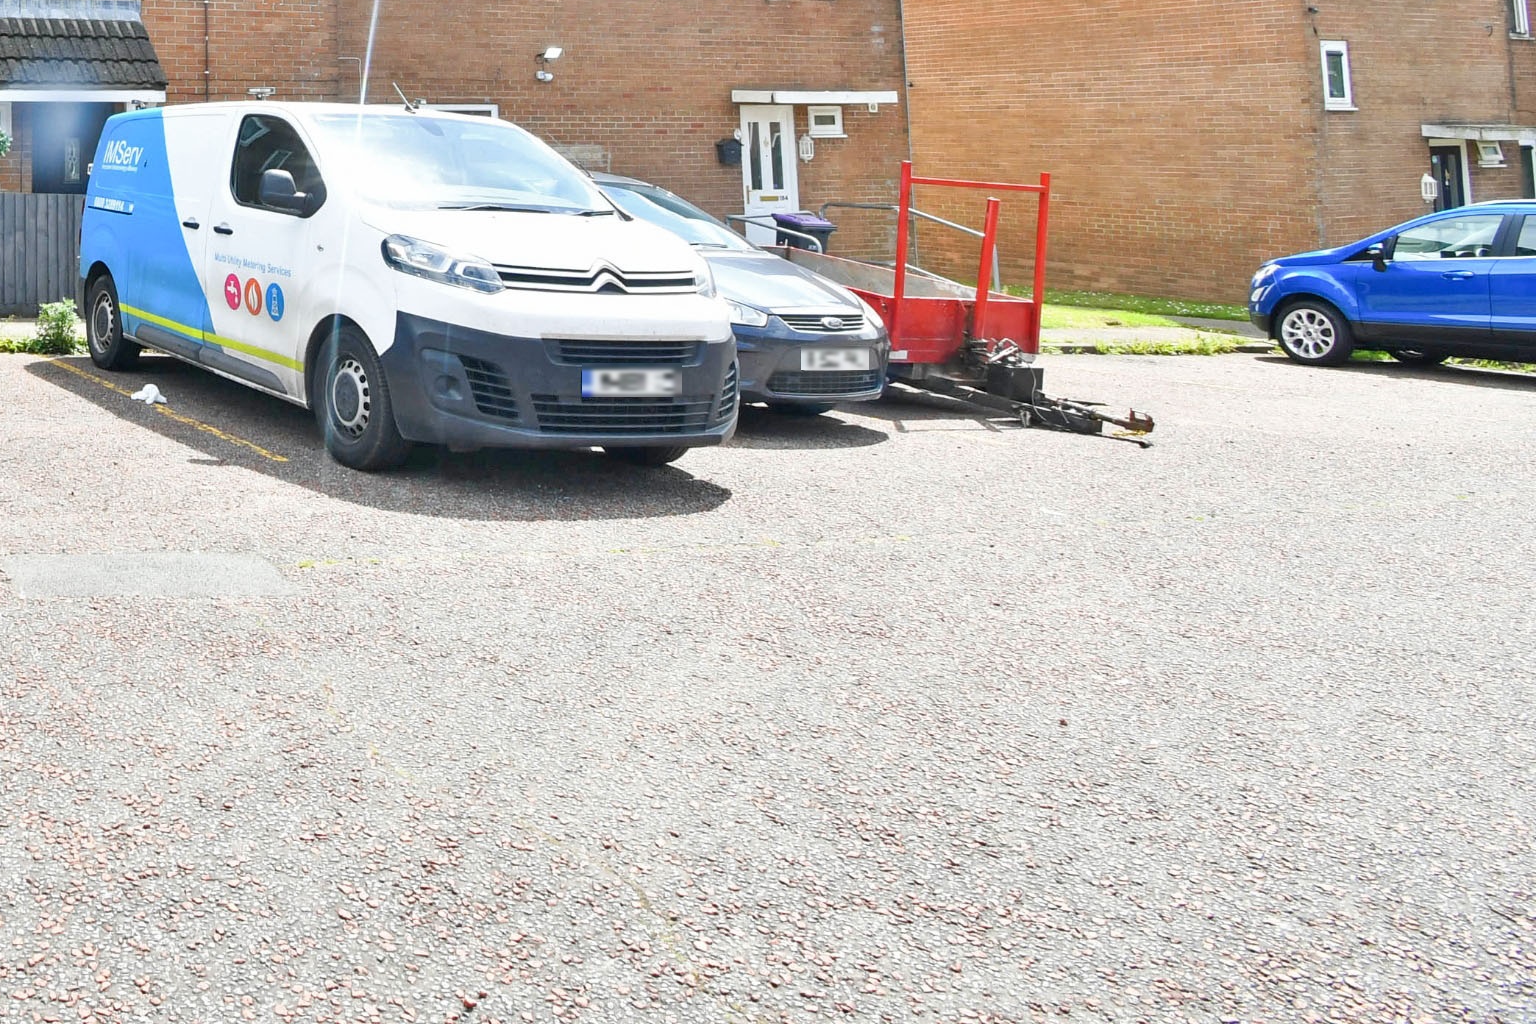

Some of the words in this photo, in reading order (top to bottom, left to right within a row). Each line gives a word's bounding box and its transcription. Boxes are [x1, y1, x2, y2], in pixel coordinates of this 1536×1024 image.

[103, 140, 144, 166] IMServ
[227, 255, 242, 268] Utility
[243, 258, 266, 274] Metering
[267, 263, 292, 278] Services
